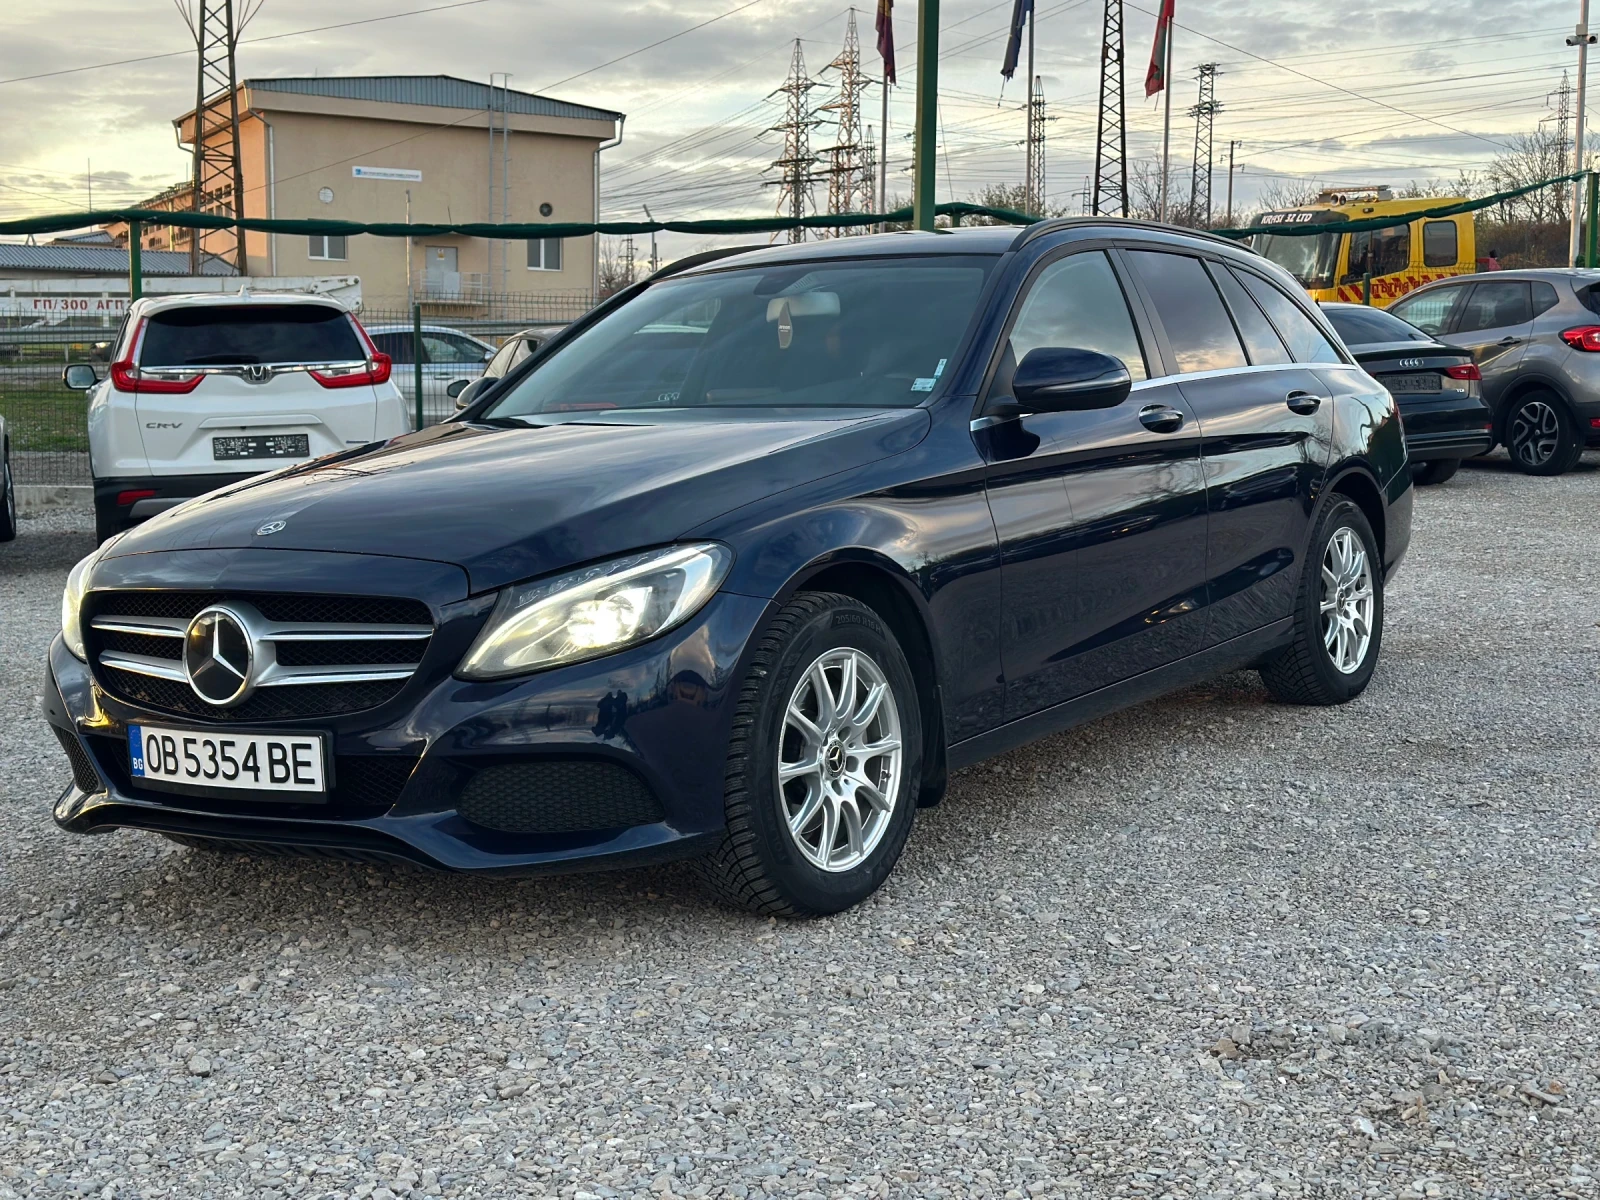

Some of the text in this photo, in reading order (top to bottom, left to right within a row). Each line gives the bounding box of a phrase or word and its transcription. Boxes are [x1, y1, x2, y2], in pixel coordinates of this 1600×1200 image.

[1260, 214, 1285, 225] KRASI
[1295, 213, 1313, 223] LTD
[33, 299, 89, 310] ГП/300
[835, 614, 861, 624] 205/60
[133, 758, 143, 770] BG
